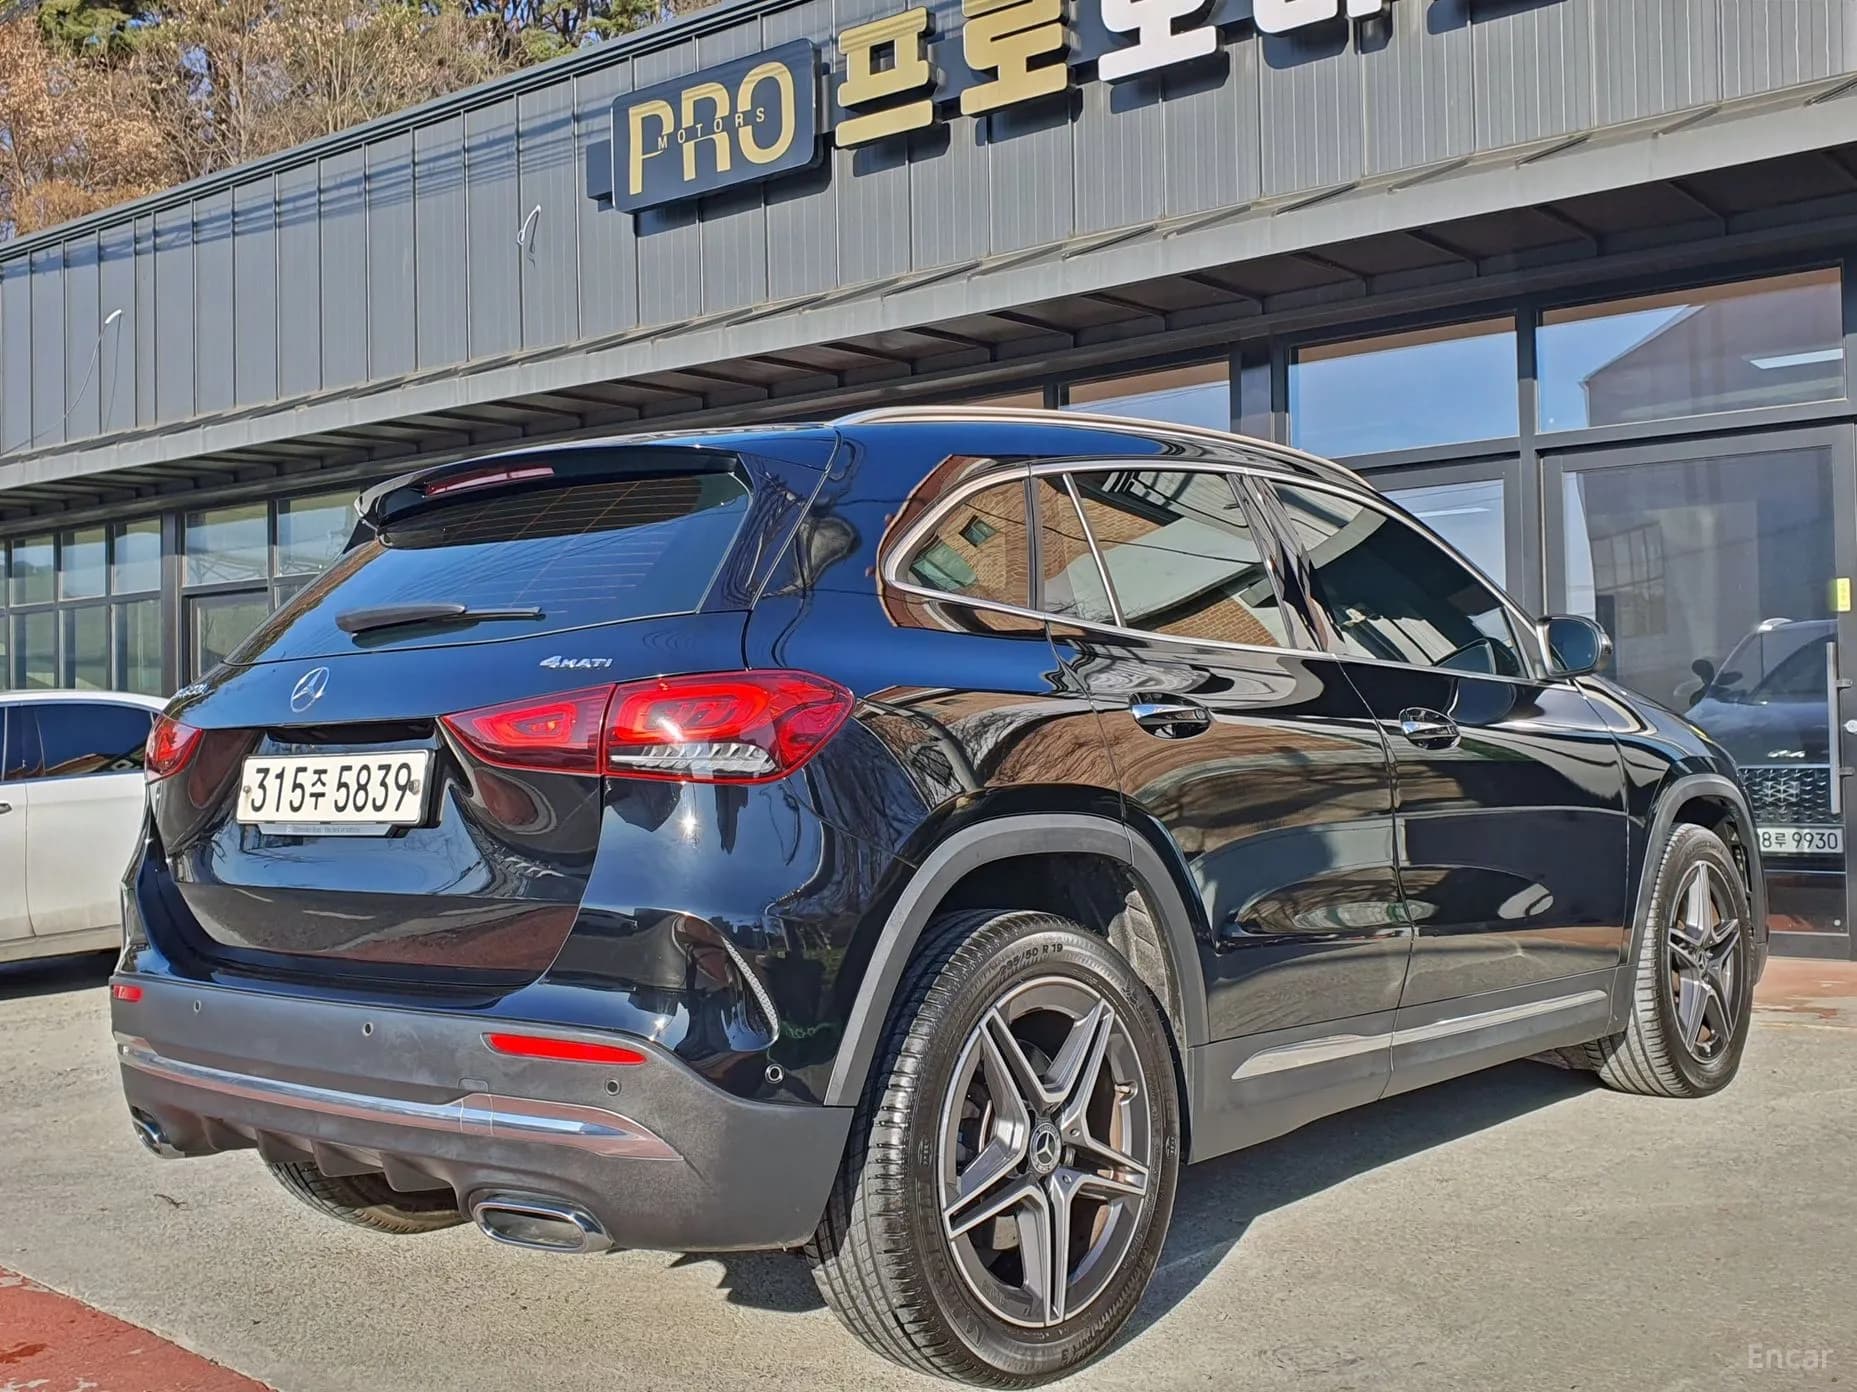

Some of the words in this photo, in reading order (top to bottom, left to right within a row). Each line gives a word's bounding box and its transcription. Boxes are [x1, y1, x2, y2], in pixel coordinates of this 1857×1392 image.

[628, 61, 796, 196] PRO
[657, 107, 765, 151] MOTORS
[251, 765, 329, 813] 315주
[334, 762, 412, 813] 5839
[1791, 831, 1838, 850] 9930
[1051, 943, 1064, 953] 19
